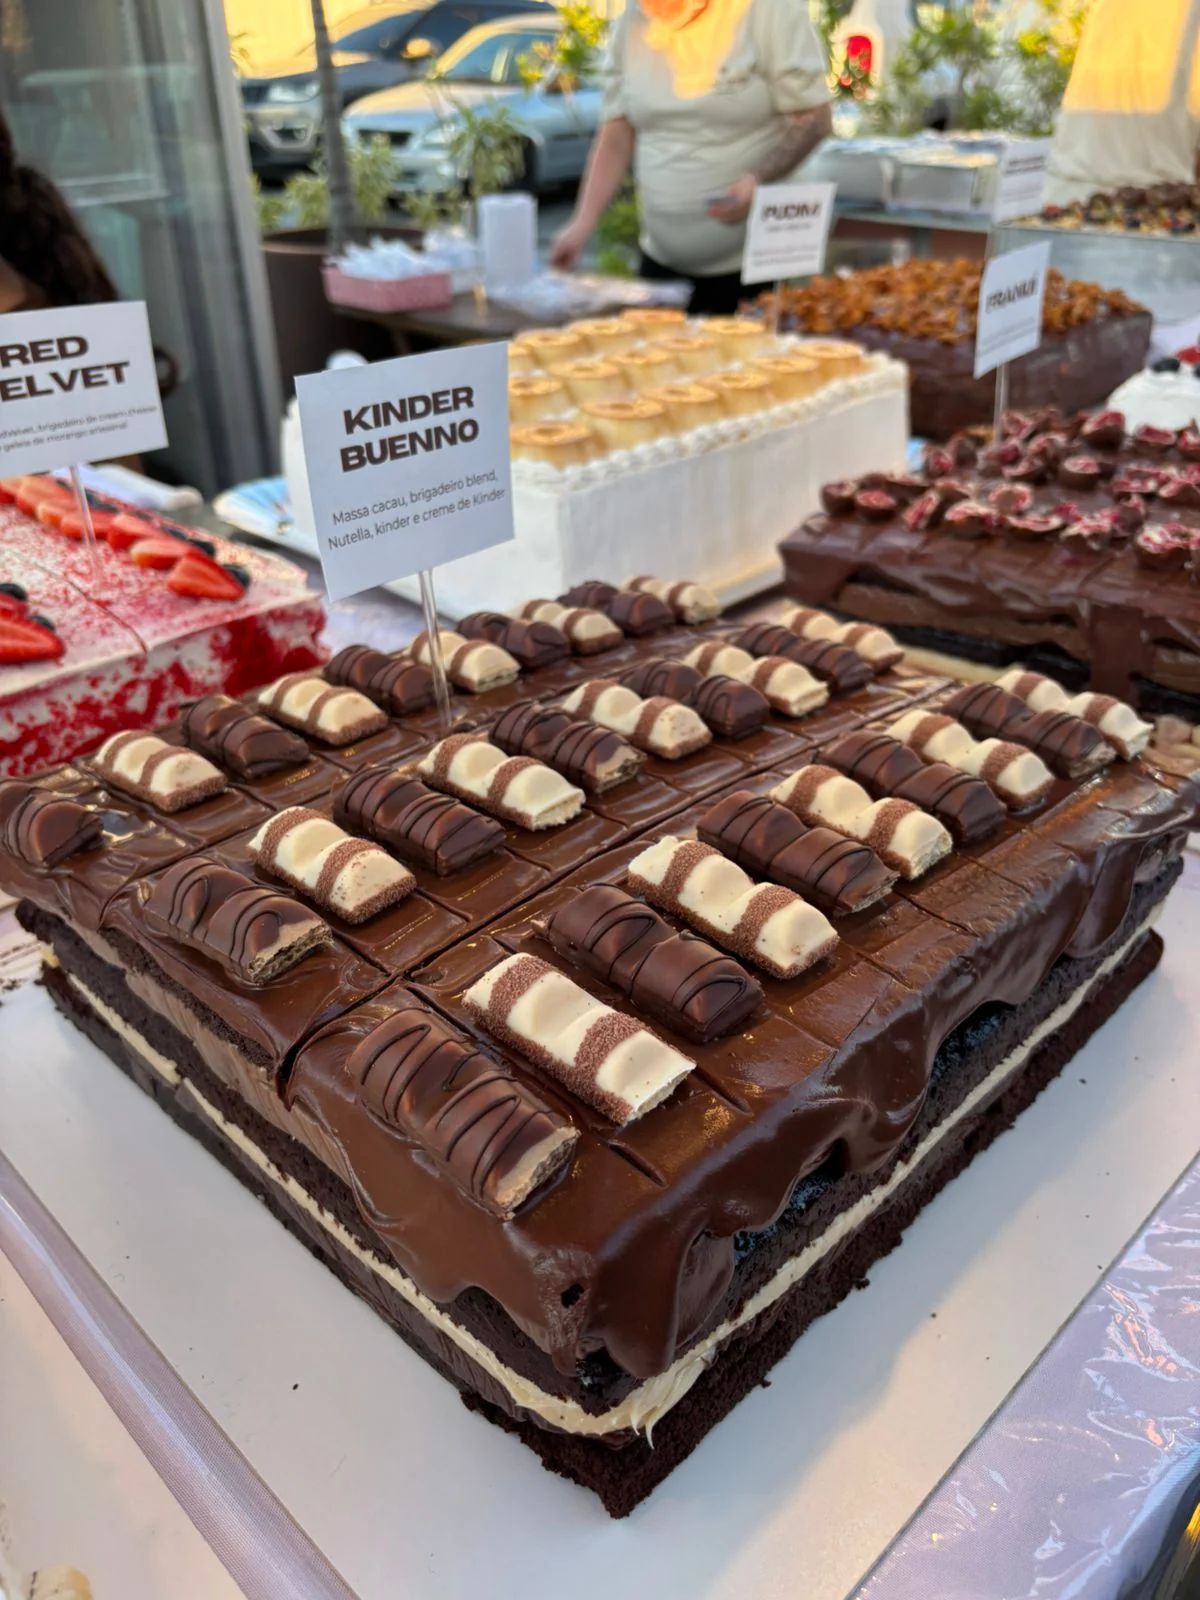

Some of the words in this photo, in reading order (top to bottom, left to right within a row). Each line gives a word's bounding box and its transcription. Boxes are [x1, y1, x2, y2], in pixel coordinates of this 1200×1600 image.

[0, 336, 89, 368] RED
[0, 361, 129, 402] ELVET
[343, 386, 475, 435] KINDER
[339, 418, 480, 473] BUENNO
[332, 506, 370, 526] Massa
[372, 496, 409, 514] cacau,
[409, 479, 465, 503] brigadeiro
[465, 468, 499, 488] blend,
[328, 527, 374, 550] Nutella,
[375, 516, 410, 536] kinder
[413, 514, 421, 524] e
[422, 503, 456, 521] creme
[457, 497, 471, 510] de
